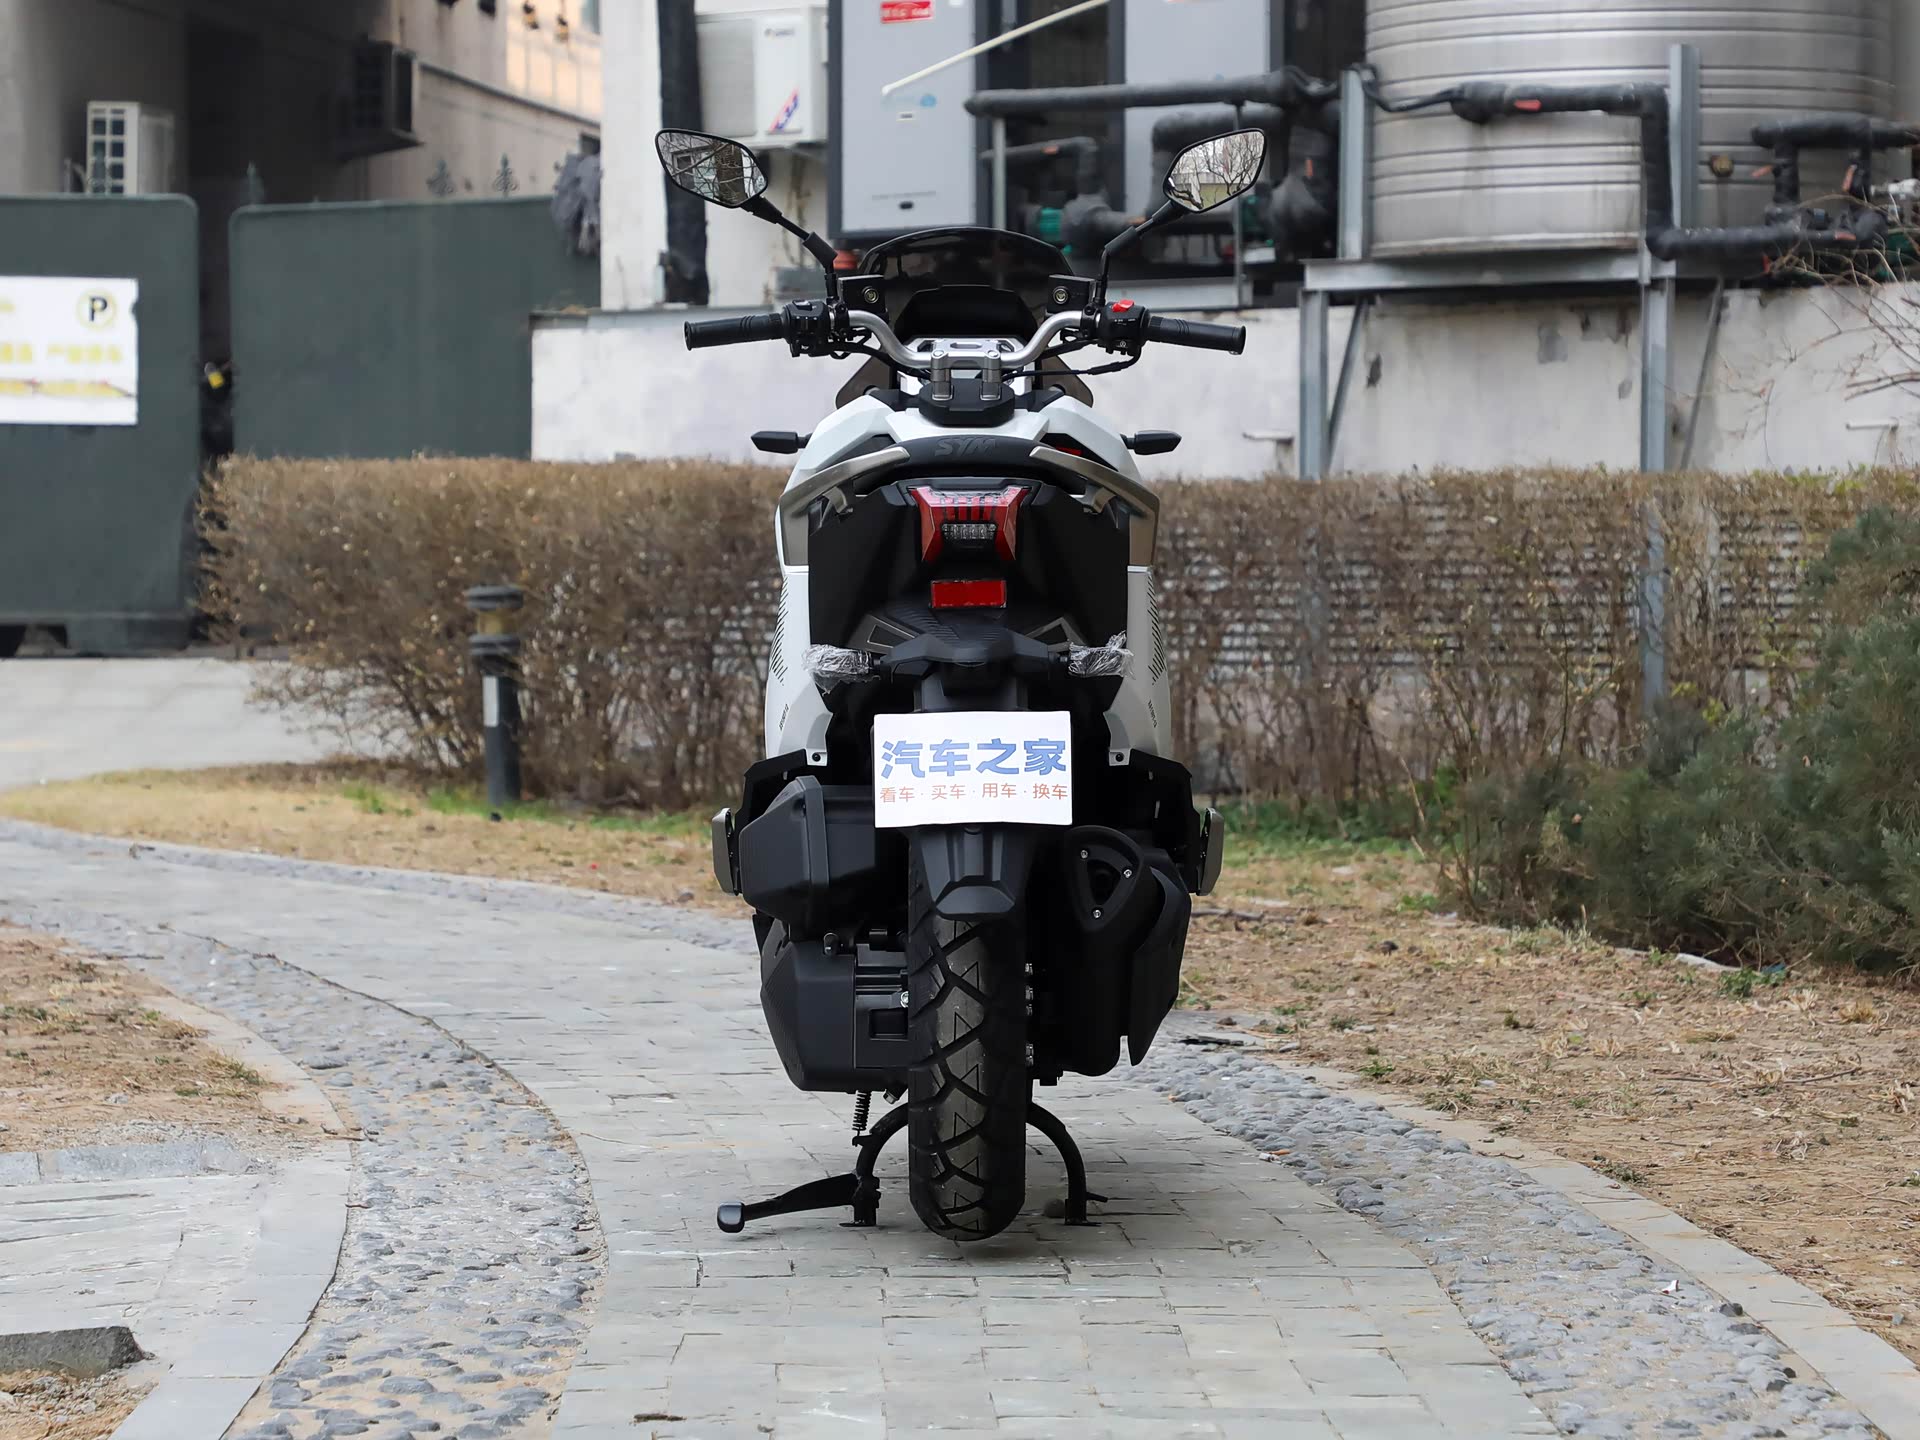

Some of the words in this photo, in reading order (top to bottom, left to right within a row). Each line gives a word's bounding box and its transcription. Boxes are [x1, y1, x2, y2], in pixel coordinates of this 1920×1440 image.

[89, 296, 108, 322] P
[934, 437, 997, 457] SYM
[881, 738, 1066, 779] 汽车之家
